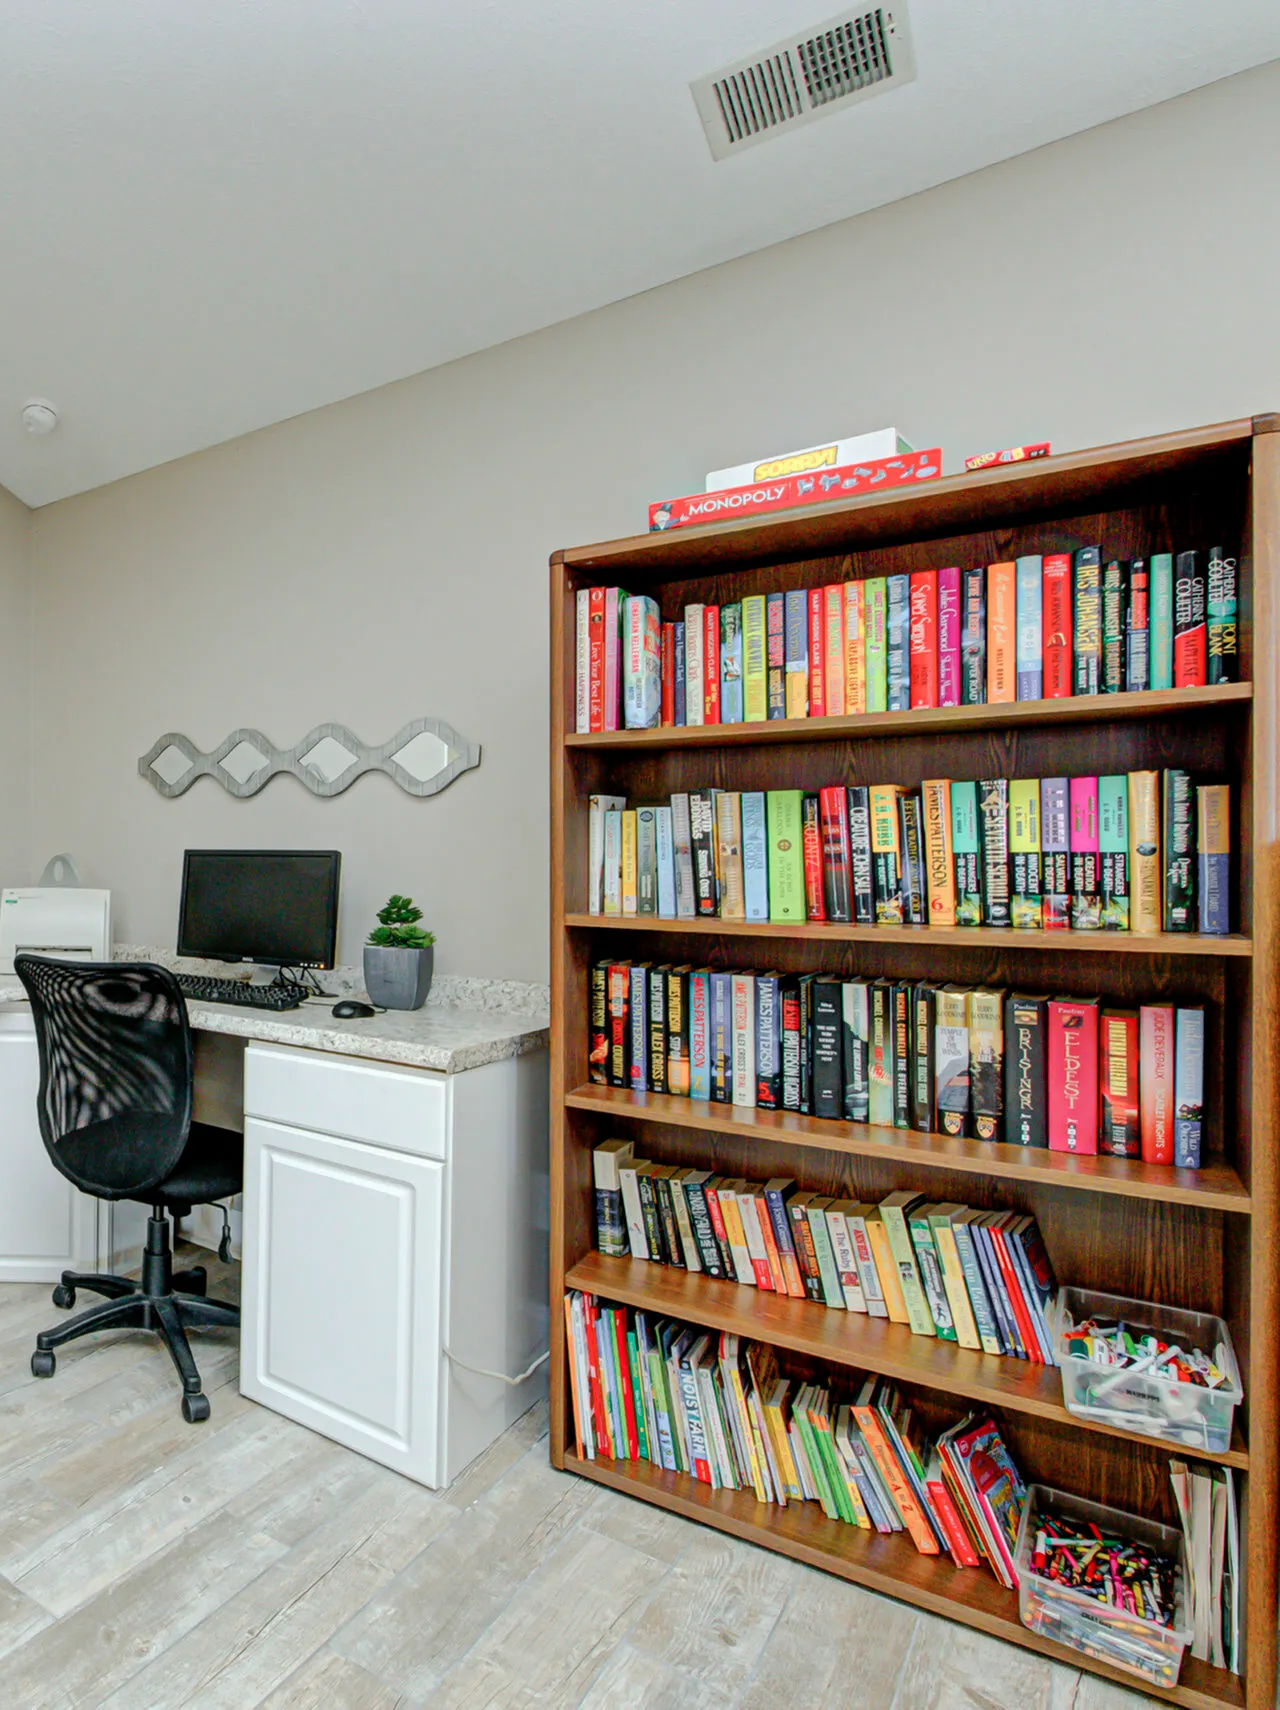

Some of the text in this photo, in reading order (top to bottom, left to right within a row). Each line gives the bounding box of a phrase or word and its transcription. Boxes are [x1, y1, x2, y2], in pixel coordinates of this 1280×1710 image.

[754, 446, 839, 482] SORRY!
[966, 452, 997, 470] UNO
[688, 486, 786, 516] MONOPOLY
[1192, 577, 1205, 622] CATHERINE
[1208, 560, 1223, 606] COULTER
[1224, 558, 1237, 604] CATHERINE
[940, 586, 957, 653] Julie Garwood
[1077, 564, 1099, 652] IRIS JOHANSEN
[1176, 578, 1191, 625] COULTER
[631, 601, 640, 674] JONATHAN KELLERMAN
[707, 632, 715, 658] HIGGINS
[747, 599, 762, 675] PATRICIA CORNWELL
[812, 594, 820, 666] MARY HIGGINS CLARK
[1105, 570, 1120, 685] IRIS JOHANSEN DEADLOCK
[1209, 625, 1223, 658] BLANK
[1223, 624, 1237, 656] POINT
[848, 642, 858, 706] EXPLOSIVE EIGHTEEN
[1184, 634, 1199, 678] IMPULSE
[578, 672, 588, 717] HAPPINESS
[590, 642, 601, 716] Live Your Best Life
[969, 680, 978, 701] ROAD
[691, 795, 703, 840] EDDINGS
[701, 801, 712, 832] DAVID
[928, 785, 947, 888] JAMES PATTERSON
[805, 821, 819, 867] KOONTZ
[851, 807, 871, 896] CREATURE JOHN SAUL
[904, 799, 914, 826] FEIST
[912, 893, 921, 912] GOD
[985, 816, 1008, 863] SEVENTH
[957, 858, 966, 889] IN DEATH
[966, 853, 976, 893] STRANGERS
[985, 865, 1008, 905] SCROLL
[1016, 855, 1025, 892] IN DEATH
[1029, 853, 1038, 893] INNOCENT
[1045, 856, 1055, 890] IN DEATH
[1056, 853, 1066, 893] SALVATION
[1074, 856, 1084, 891] IN DEATH
[1085, 855, 1095, 892] CREATION
[1103, 858, 1113, 891] IN DEATH
[1115, 853, 1125, 895] STRANGERS
[668, 975, 681, 996] JAMES
[612, 1020, 623, 1045] CROSS
[631, 974, 643, 1060] JAMES PATTERSON
[668, 996, 681, 1033] PATTERSON
[692, 977, 706, 1068] JAMES PATTERSON
[758, 982, 772, 1078] JAMES PATTERSON
[940, 1028, 963, 1036] TEMPLE
[1153, 1011, 1165, 1033] JUDE
[651, 1031, 664, 1052] ALEX
[736, 1033, 747, 1047] ALEX
[783, 1037, 800, 1076] PATTERSON
[897, 993, 906, 1108] MICHAEL CONNELLY THE OVERLOOK
[1153, 1035, 1165, 1080] DEVERAUX
[612, 1045, 623, 1078] COUNTRY
[651, 1053, 664, 1080] CROSS
[1018, 1028, 1034, 1111] BRISINGR
[1063, 1031, 1081, 1109] ELDEST
[1155, 1120, 1165, 1148] NIGHTS
[1190, 1130, 1200, 1151] WILD
[838, 1248, 850, 1270] Ruby
[680, 1374, 706, 1456] NOISY FARM
[900, 1503, 914, 1513] Z
